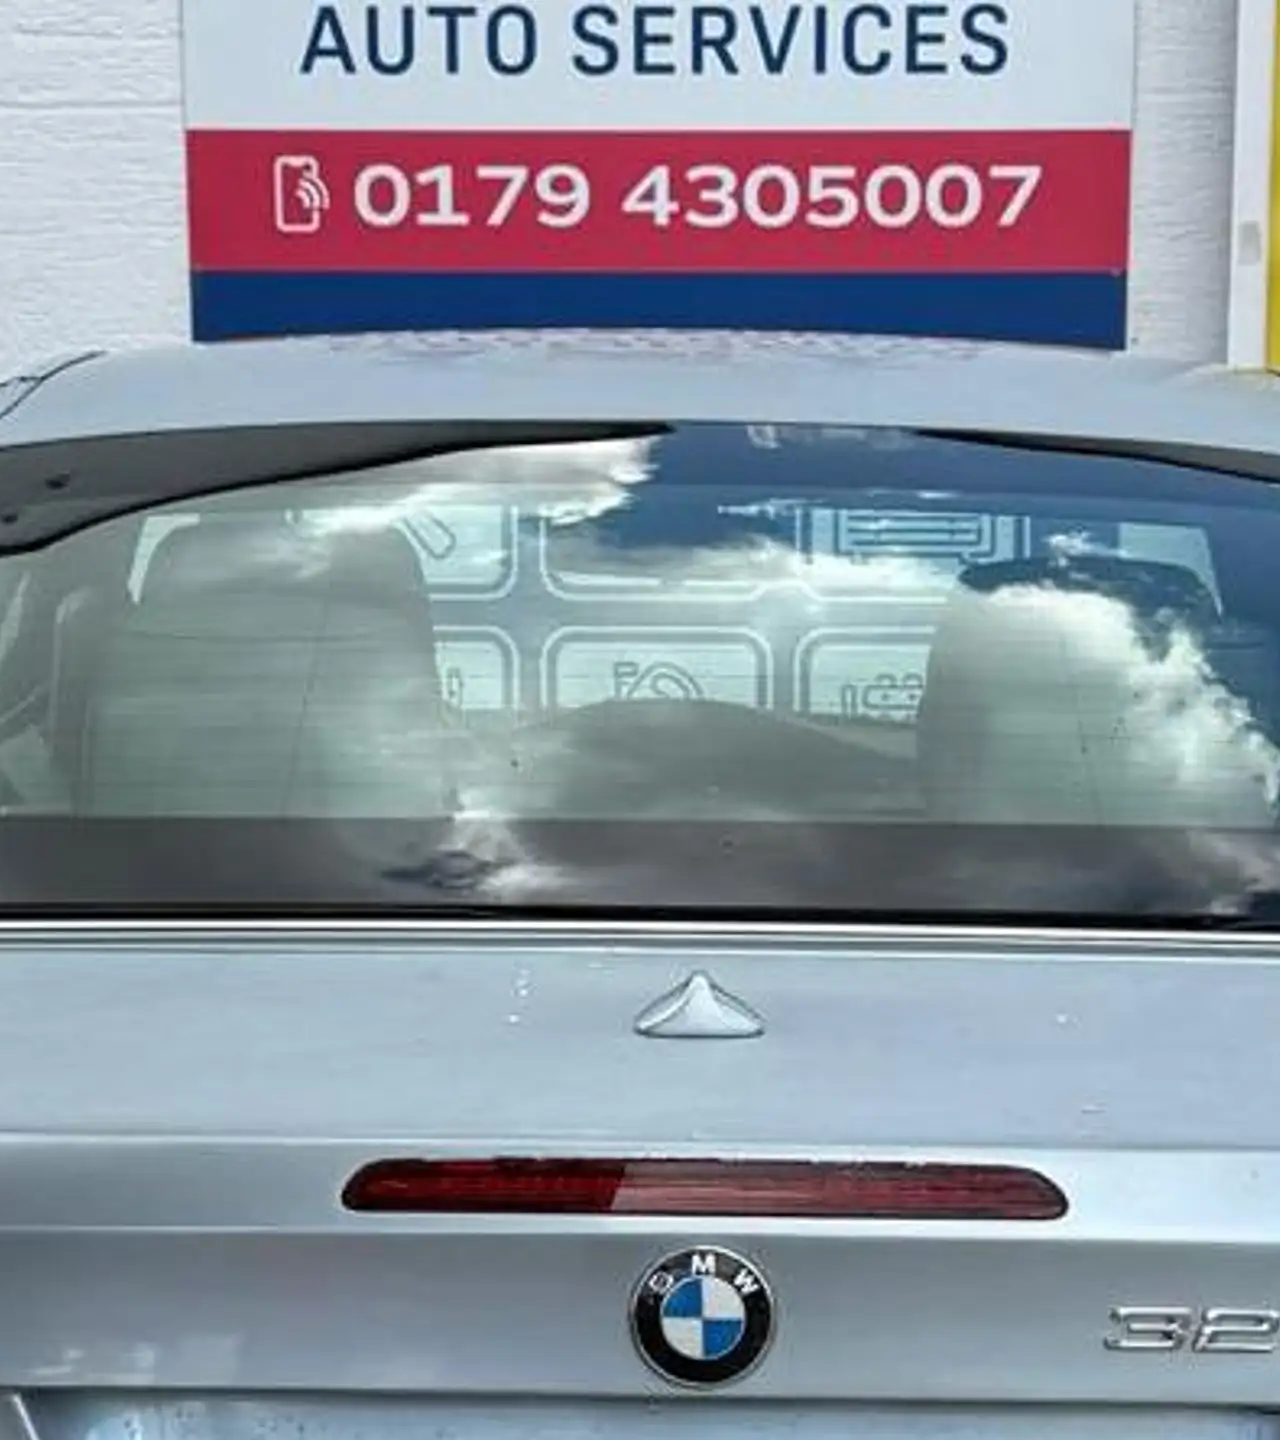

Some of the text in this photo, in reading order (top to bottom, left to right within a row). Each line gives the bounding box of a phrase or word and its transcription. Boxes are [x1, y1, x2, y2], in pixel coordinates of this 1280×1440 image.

[300, 4, 1009, 76] AUTO SERVICES
[353, 162, 1043, 229] 0179 4305007
[648, 1252, 760, 1296] BMW
